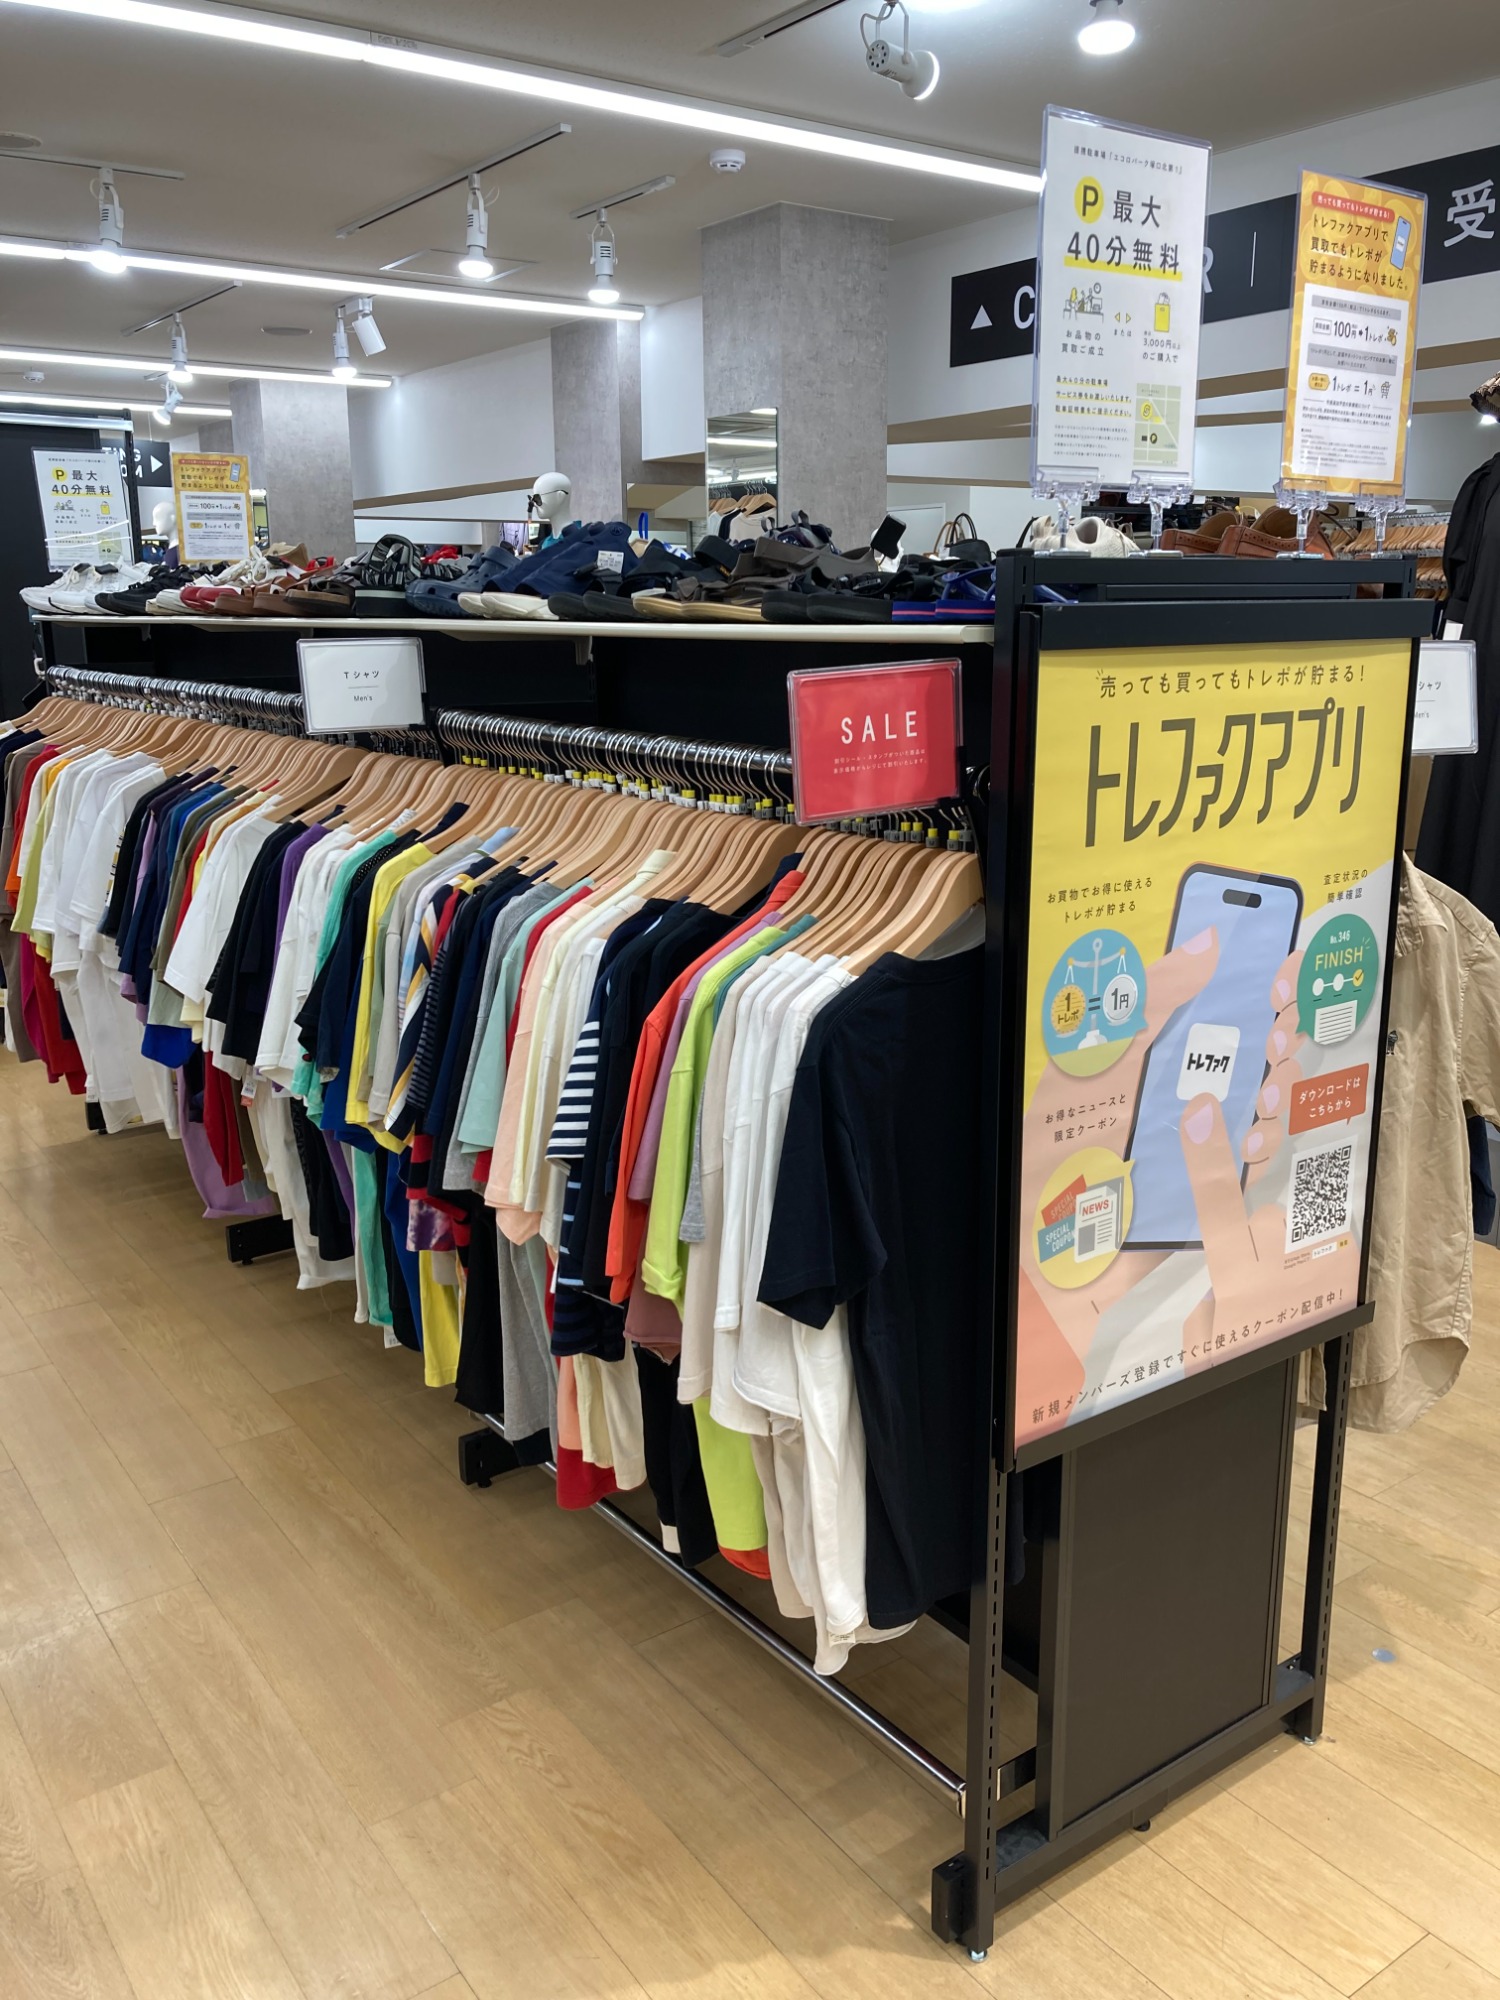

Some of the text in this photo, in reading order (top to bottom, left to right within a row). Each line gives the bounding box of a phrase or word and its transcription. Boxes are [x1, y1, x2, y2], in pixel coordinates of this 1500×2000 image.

[1081, 184, 1162, 228] P 最大
[1313, 213, 1389, 243] トレファクアプリで
[1066, 231, 1180, 276] 40分無料
[1310, 236, 1383, 263] 買取でもトレポが
[1309, 258, 1408, 291] 貯まるようになりました。
[1065, 329, 1101, 341] お品物の
[1113, 328, 1132, 337] または
[1061, 342, 1104, 356] 買取ご成立
[1142, 351, 1179, 363] のご購入で
[55, 469, 98, 481] P 最大
[51, 484, 111, 496] 40分無料
[344, 671, 379, 679] Tシャツ
[1418, 680, 1442, 691] シャツ
[841, 710, 918, 745] SALE
[1085, 696, 1366, 848] トレファクアプリ
[1323, 869, 1368, 886] 査定状況の
[1047, 877, 1153, 904] お買物でお得に使える
[1327, 887, 1363, 903] 簡単確認
[1064, 900, 1137, 923] トレポが貯まる
[1315, 946, 1363, 972] FINISH
[1064, 992, 1072, 1012] 1
[1110, 987, 1129, 1011] 1円
[1057, 1009, 1080, 1024] トレポ
[1187, 1053, 1231, 1073] トレファク
[1299, 1076, 1362, 1104] ダウンロードは
[1045, 1093, 1126, 1125] お得なニュースと
[1308, 1095, 1352, 1119] こちらから
[1054, 1116, 1118, 1144] 限定クーポン
[1082, 1199, 1109, 1216] NEWS
[1045, 1222, 1070, 1245] SPECIAL
